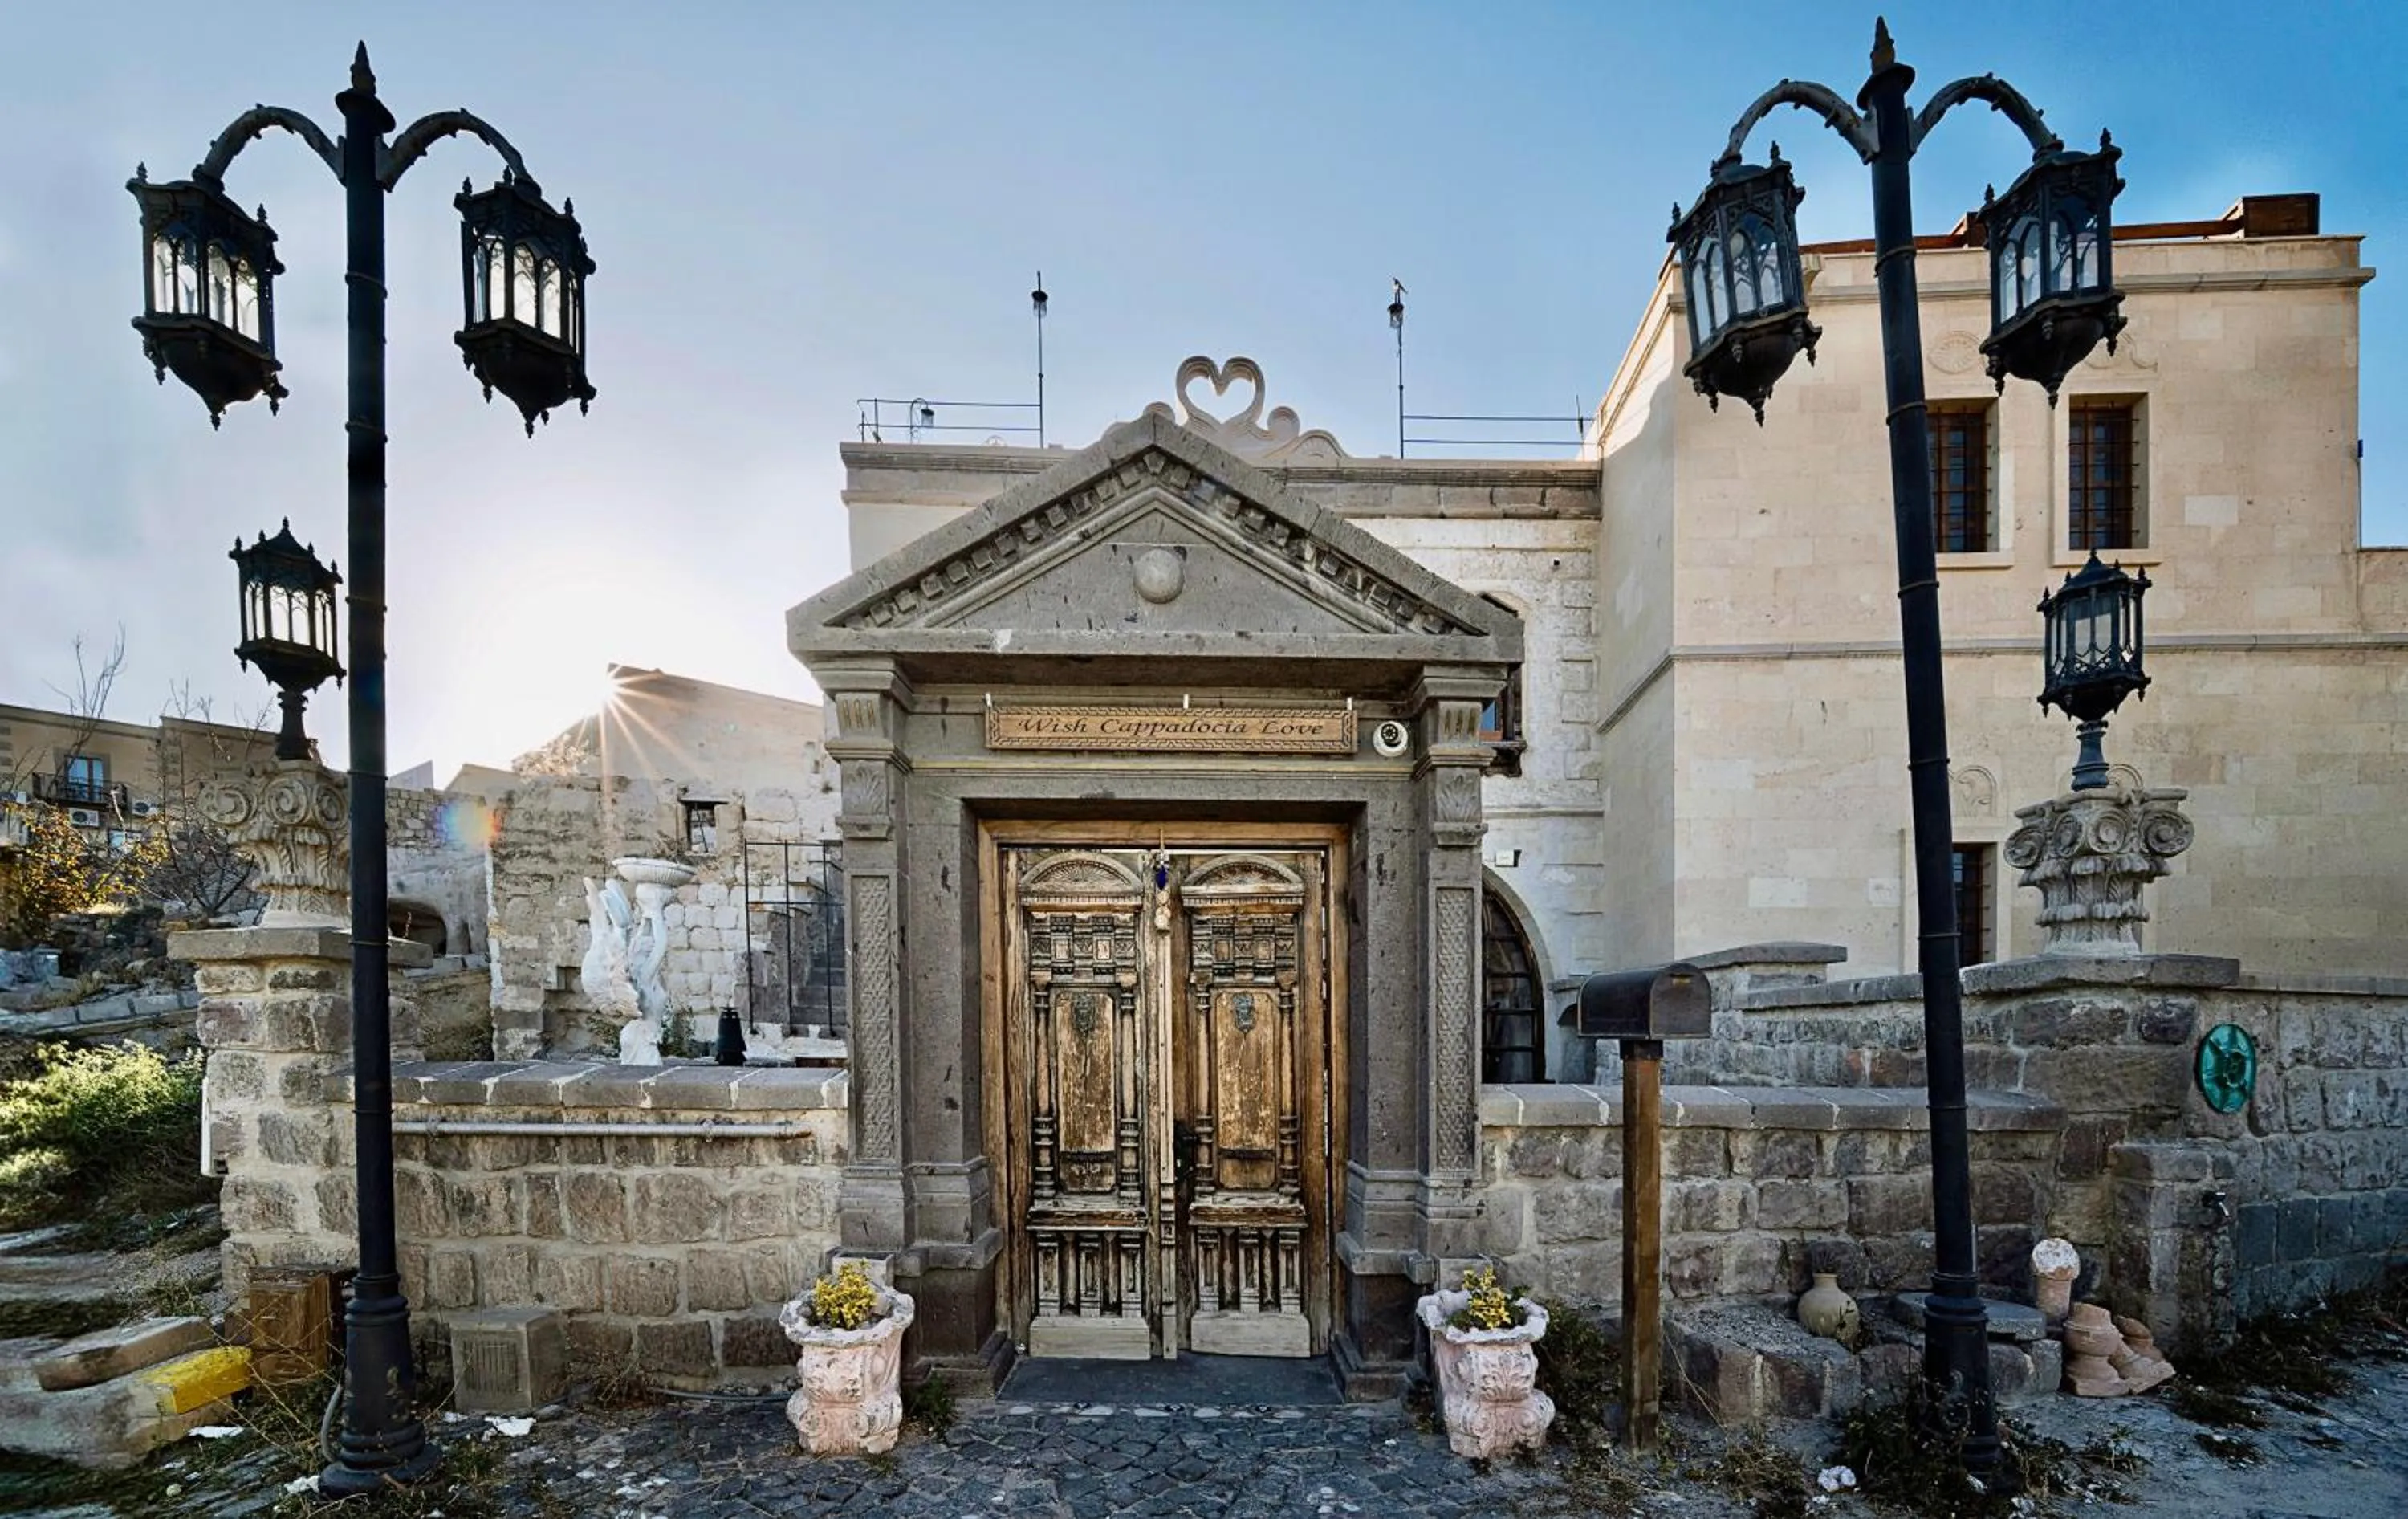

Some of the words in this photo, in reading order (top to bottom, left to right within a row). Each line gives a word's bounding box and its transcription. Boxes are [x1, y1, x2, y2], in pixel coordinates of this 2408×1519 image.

[1018, 717, 1088, 733] Wish
[1100, 719, 1247, 736] Cappadocia
[1260, 719, 1324, 735] Love
